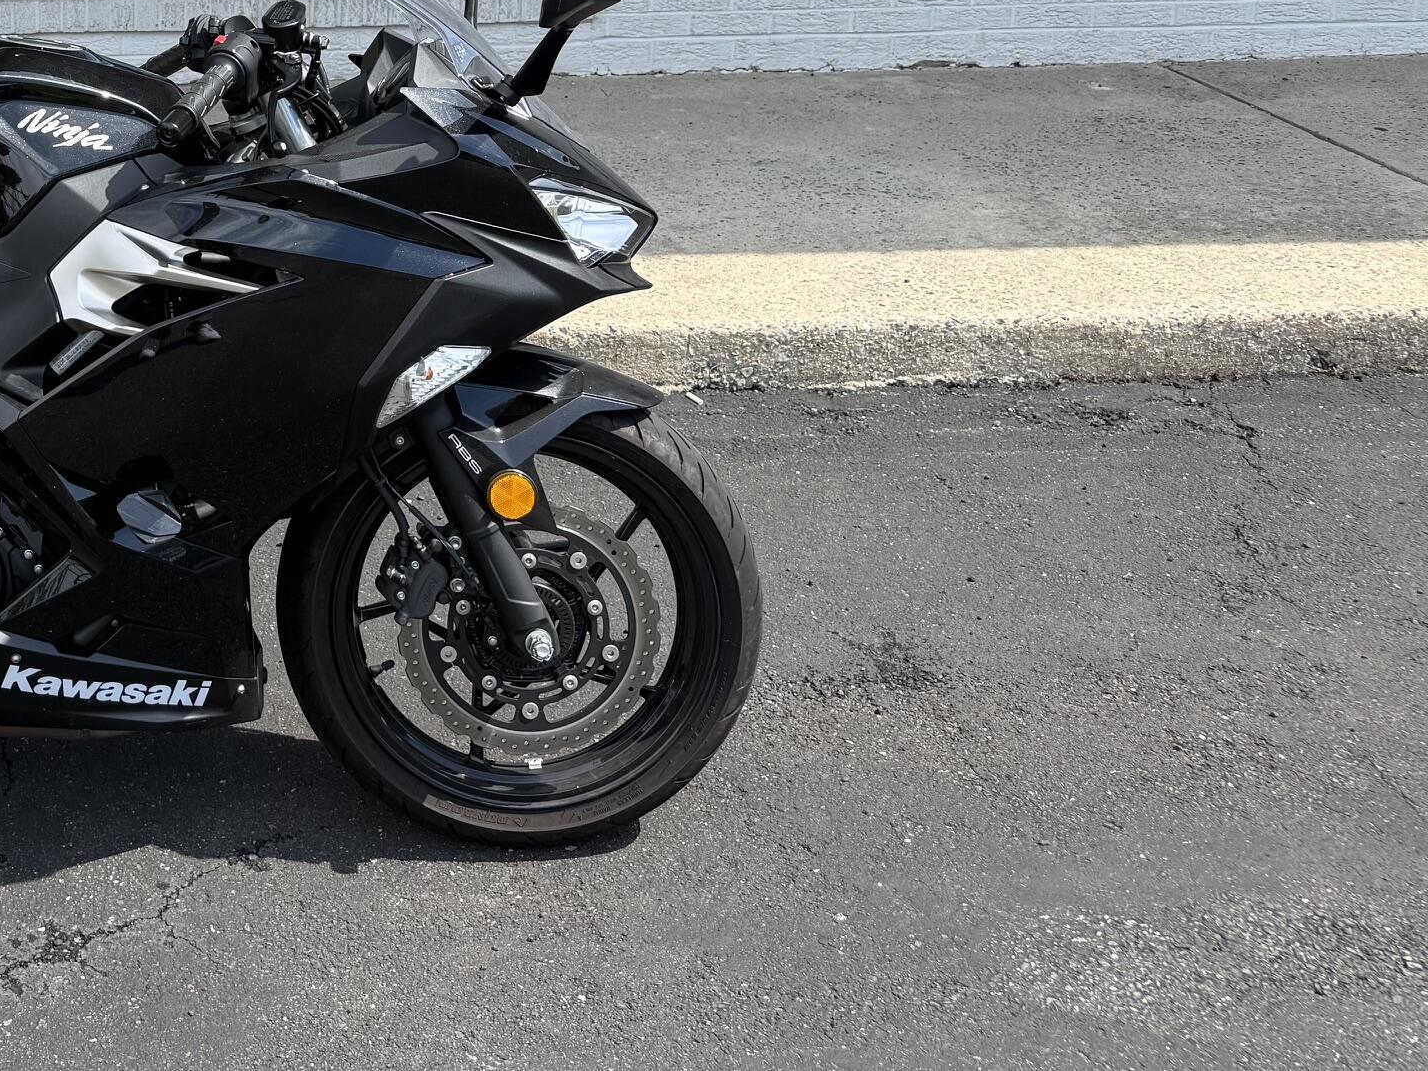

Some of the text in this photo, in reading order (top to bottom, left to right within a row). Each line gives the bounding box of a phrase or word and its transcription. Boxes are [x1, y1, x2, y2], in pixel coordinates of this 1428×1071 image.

[17, 108, 114, 151] Ninja
[448, 433, 483, 475] ABS
[0, 664, 213, 707] Kawasaki
